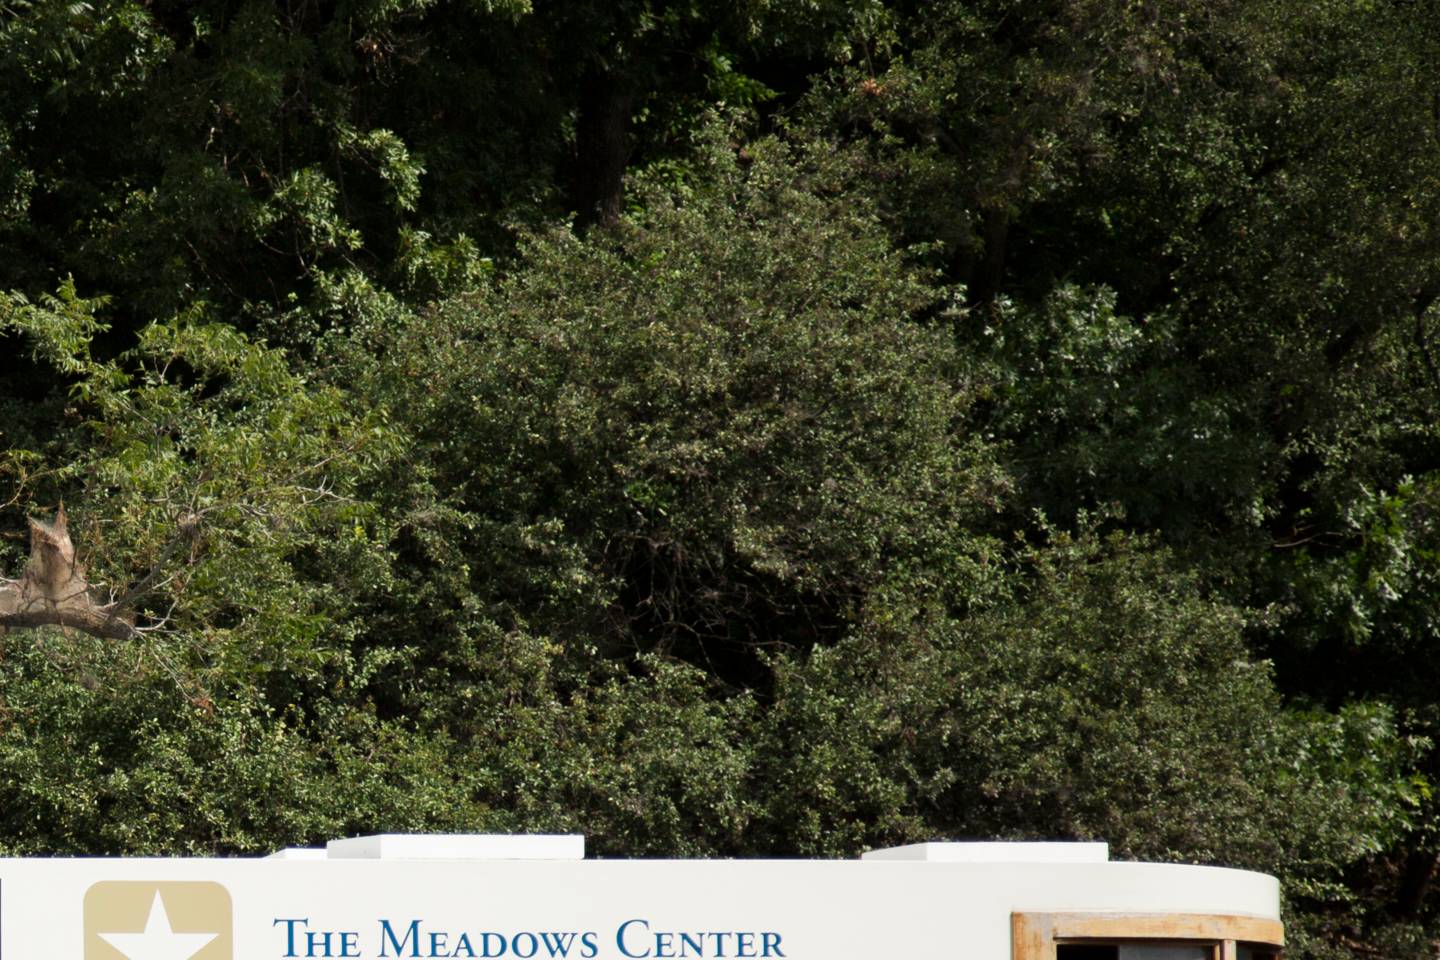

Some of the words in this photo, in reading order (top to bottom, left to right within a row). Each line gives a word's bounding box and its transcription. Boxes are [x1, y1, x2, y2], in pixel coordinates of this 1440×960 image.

[273, 917, 362, 958] THE
[377, 918, 599, 958] MEADOWS
[616, 918, 786, 958] CENTER
